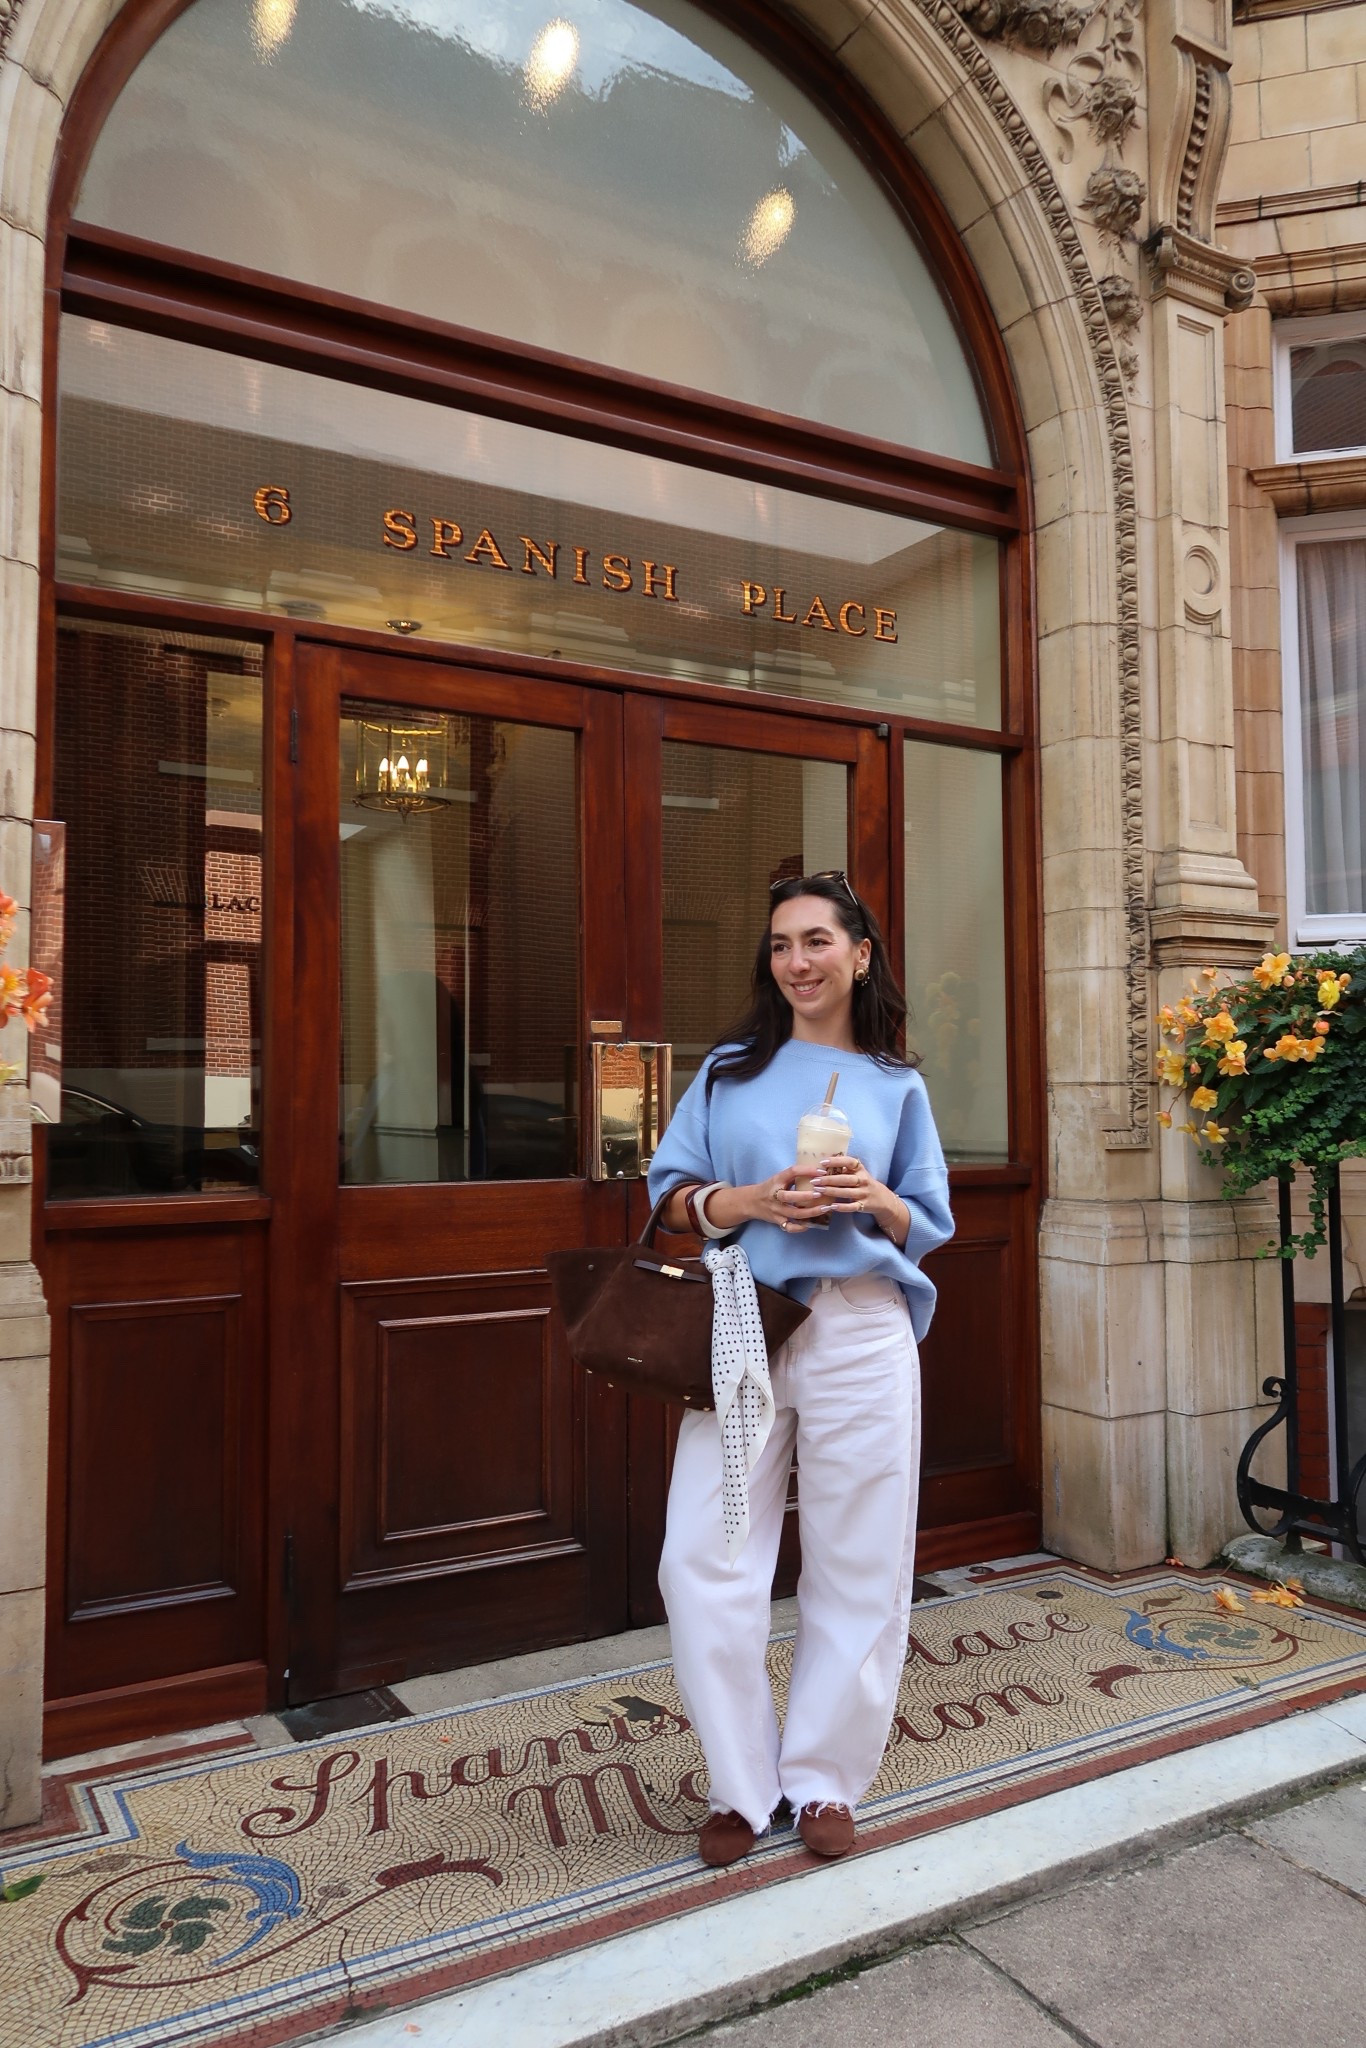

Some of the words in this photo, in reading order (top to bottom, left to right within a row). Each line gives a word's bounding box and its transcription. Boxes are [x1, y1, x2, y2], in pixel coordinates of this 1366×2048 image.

[253, 484, 293, 526] 6
[383, 508, 680, 602] SPANISH
[740, 580, 899, 644] PLACE
[211, 893, 260, 912] LAC
[240, 1706, 692, 1837] Spanis
[906, 1612, 1090, 1666] lace
